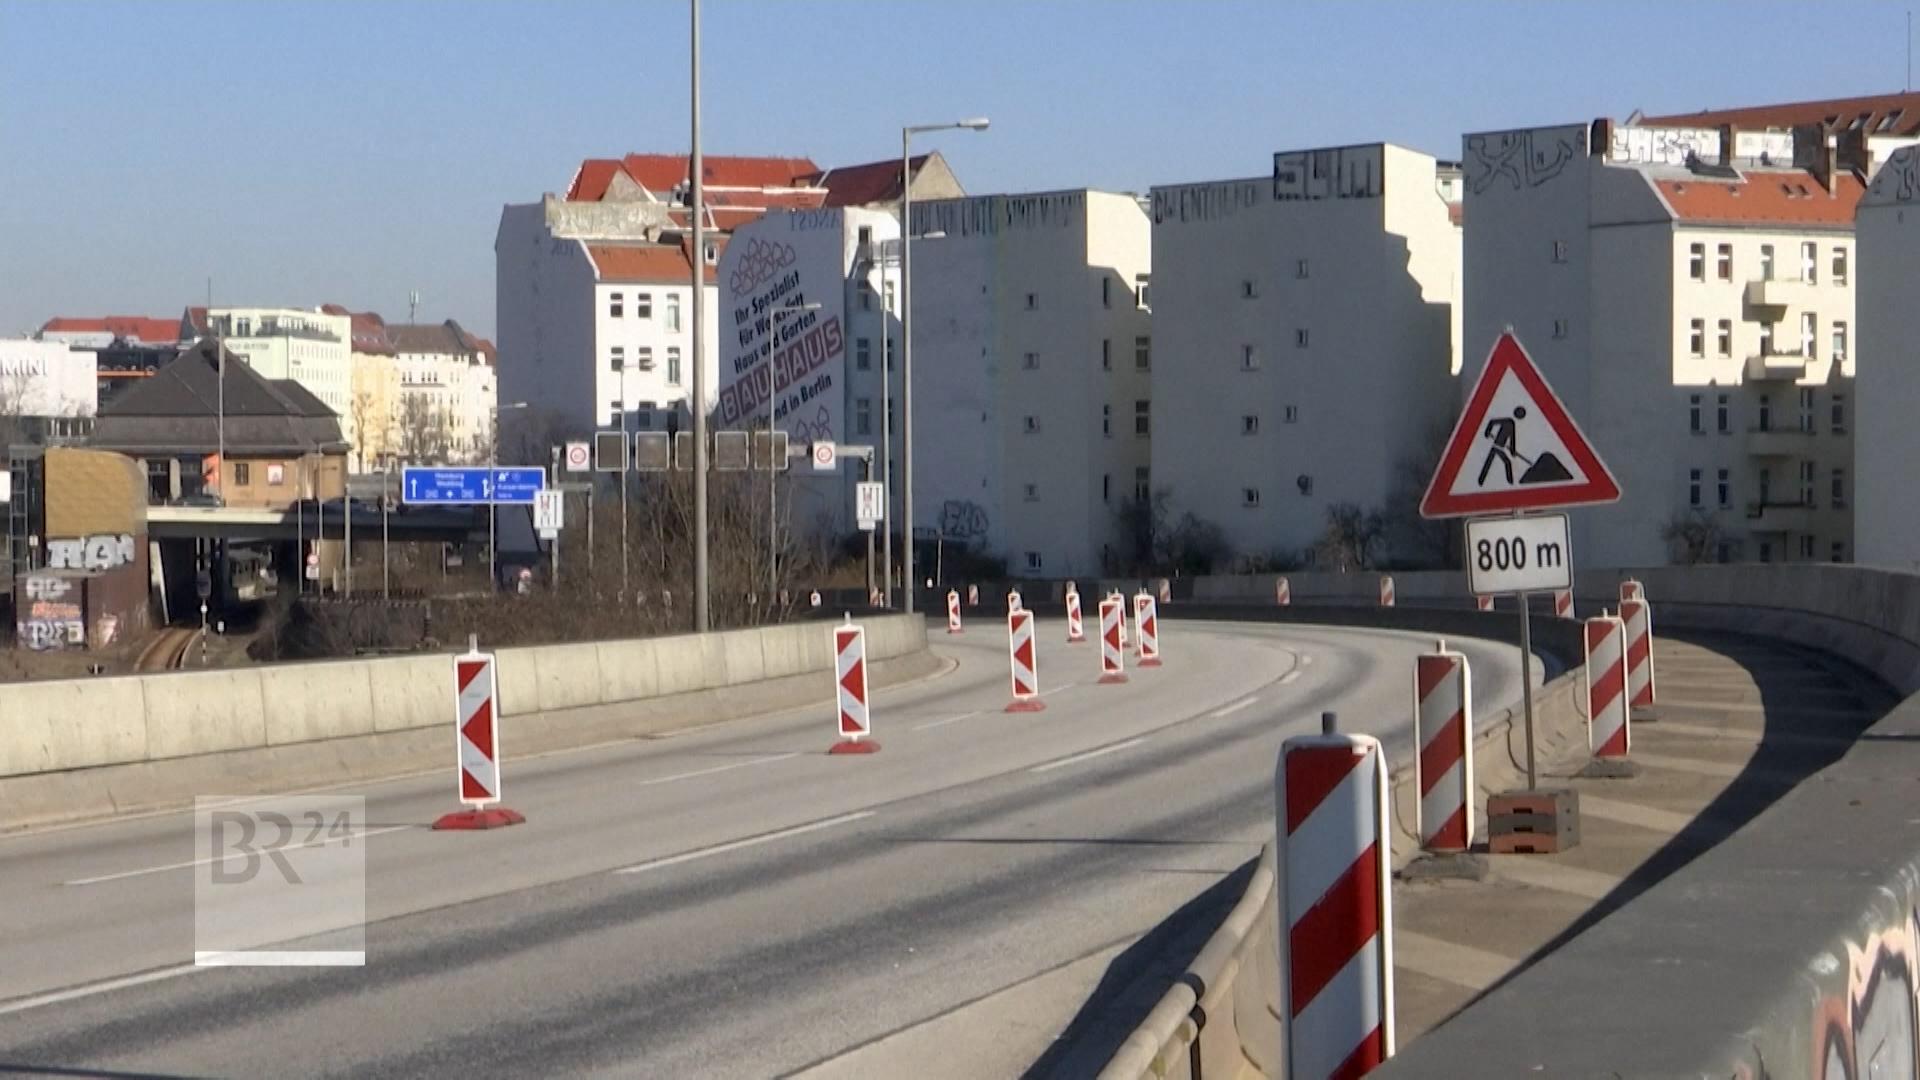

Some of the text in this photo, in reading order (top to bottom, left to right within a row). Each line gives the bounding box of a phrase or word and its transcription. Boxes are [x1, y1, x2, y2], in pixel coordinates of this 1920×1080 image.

[735, 270, 799, 325] Ihr Spezialist
[734, 349, 759, 374] Haus
[781, 311, 816, 342] Garten
[740, 328, 753, 348] für
[721, 318, 842, 425] BAUHAUS
[800, 374, 832, 404] Berlin
[1478, 537, 1561, 571] 800 m
